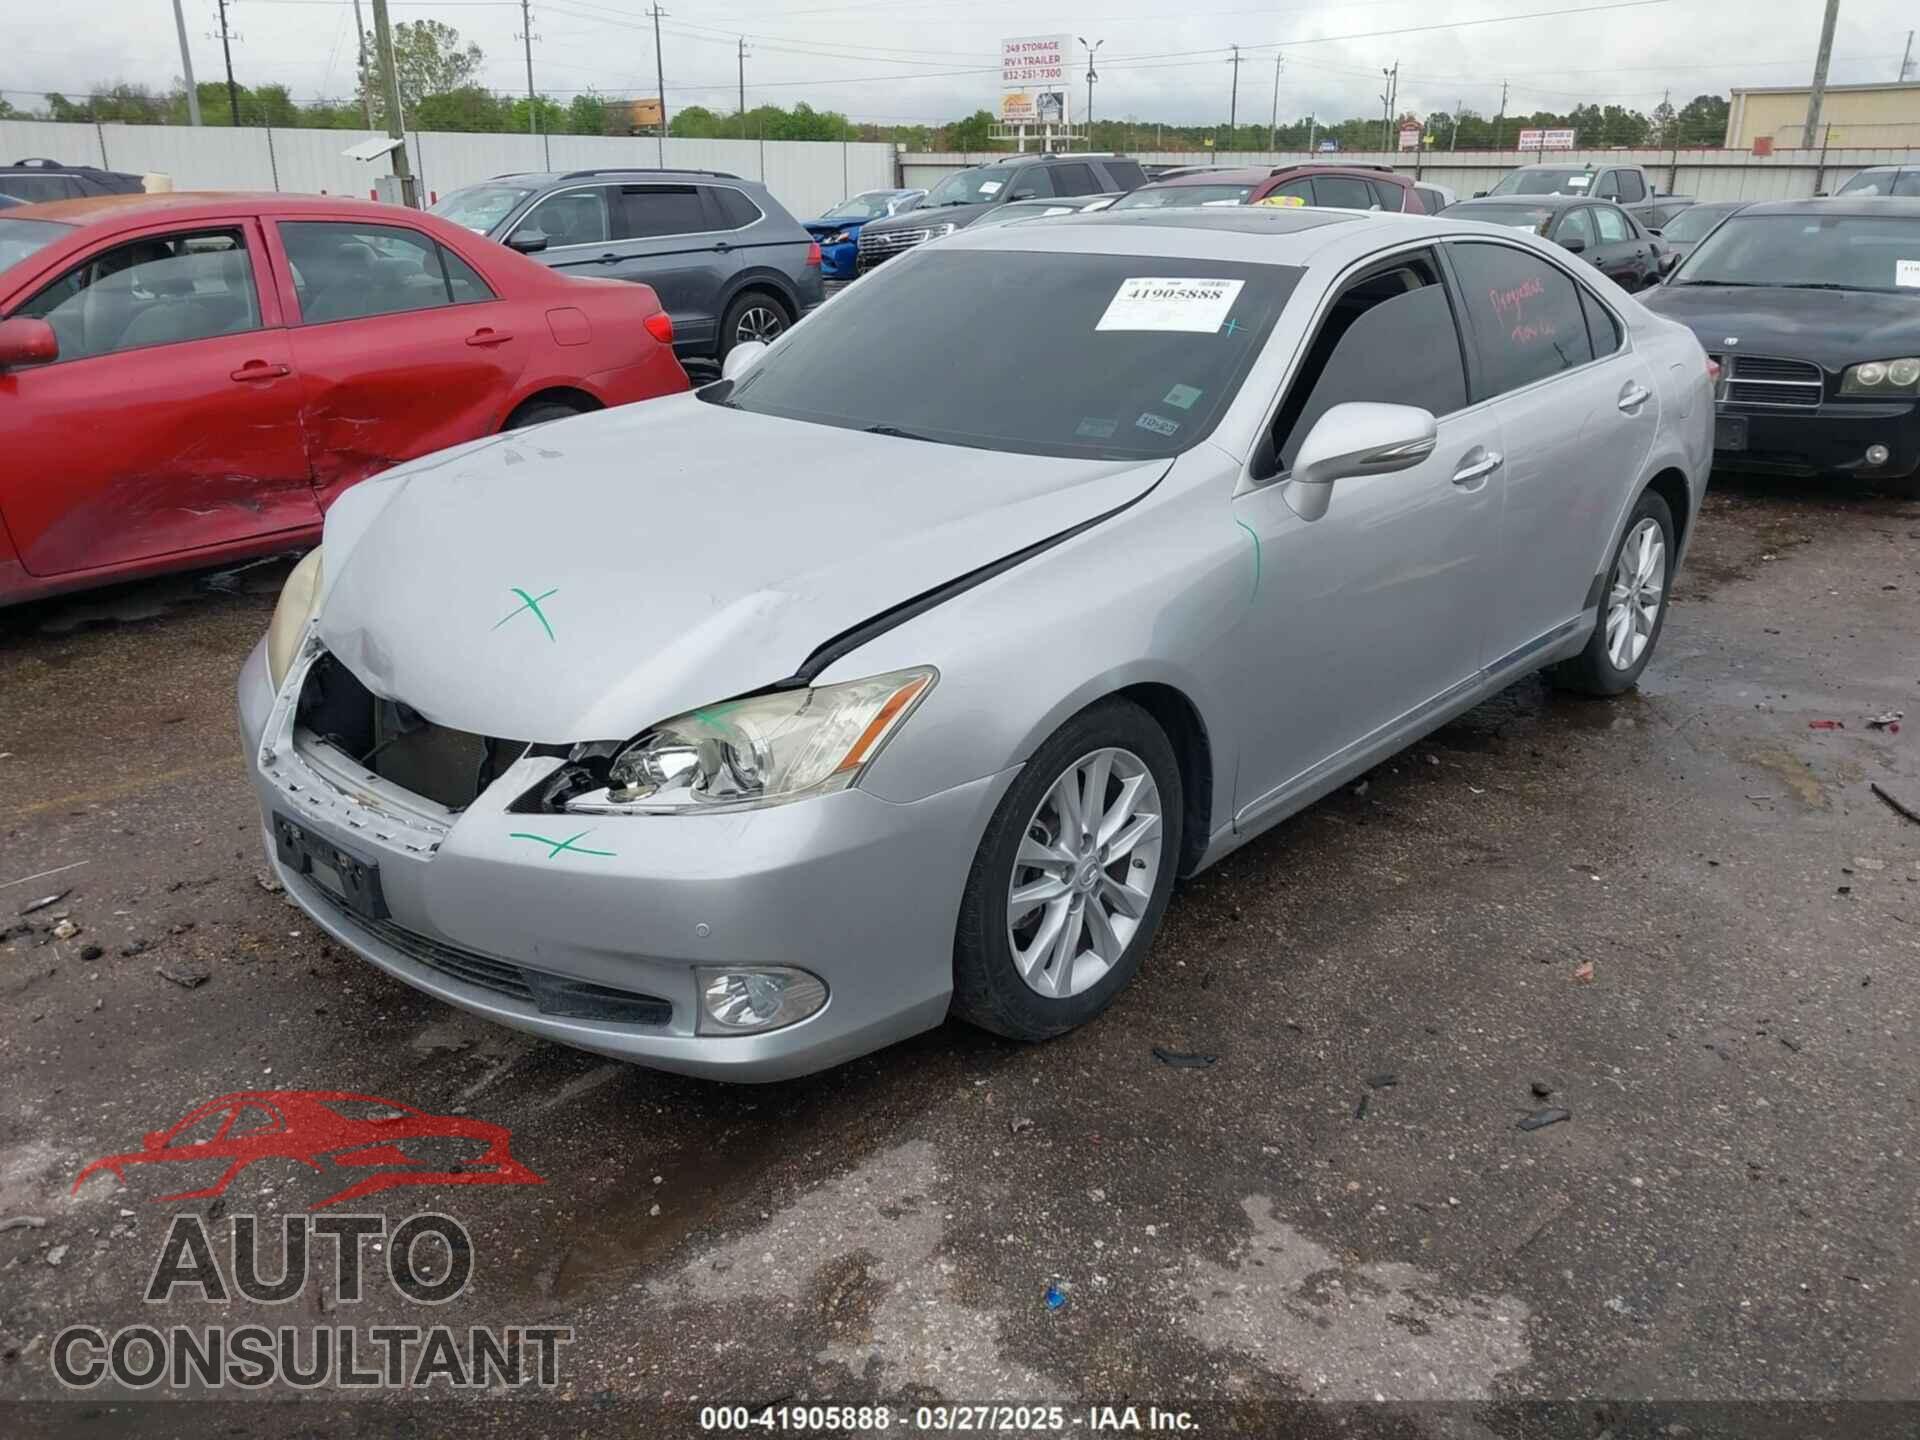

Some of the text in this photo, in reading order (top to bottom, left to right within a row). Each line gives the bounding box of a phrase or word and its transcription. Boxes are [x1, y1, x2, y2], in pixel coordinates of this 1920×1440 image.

[1022, 42, 1059, 52] STORAGE
[1004, 57, 1016, 66] RV
[1023, 55, 1061, 66] TRAILER
[1128, 289, 1223, 300] 41905888
